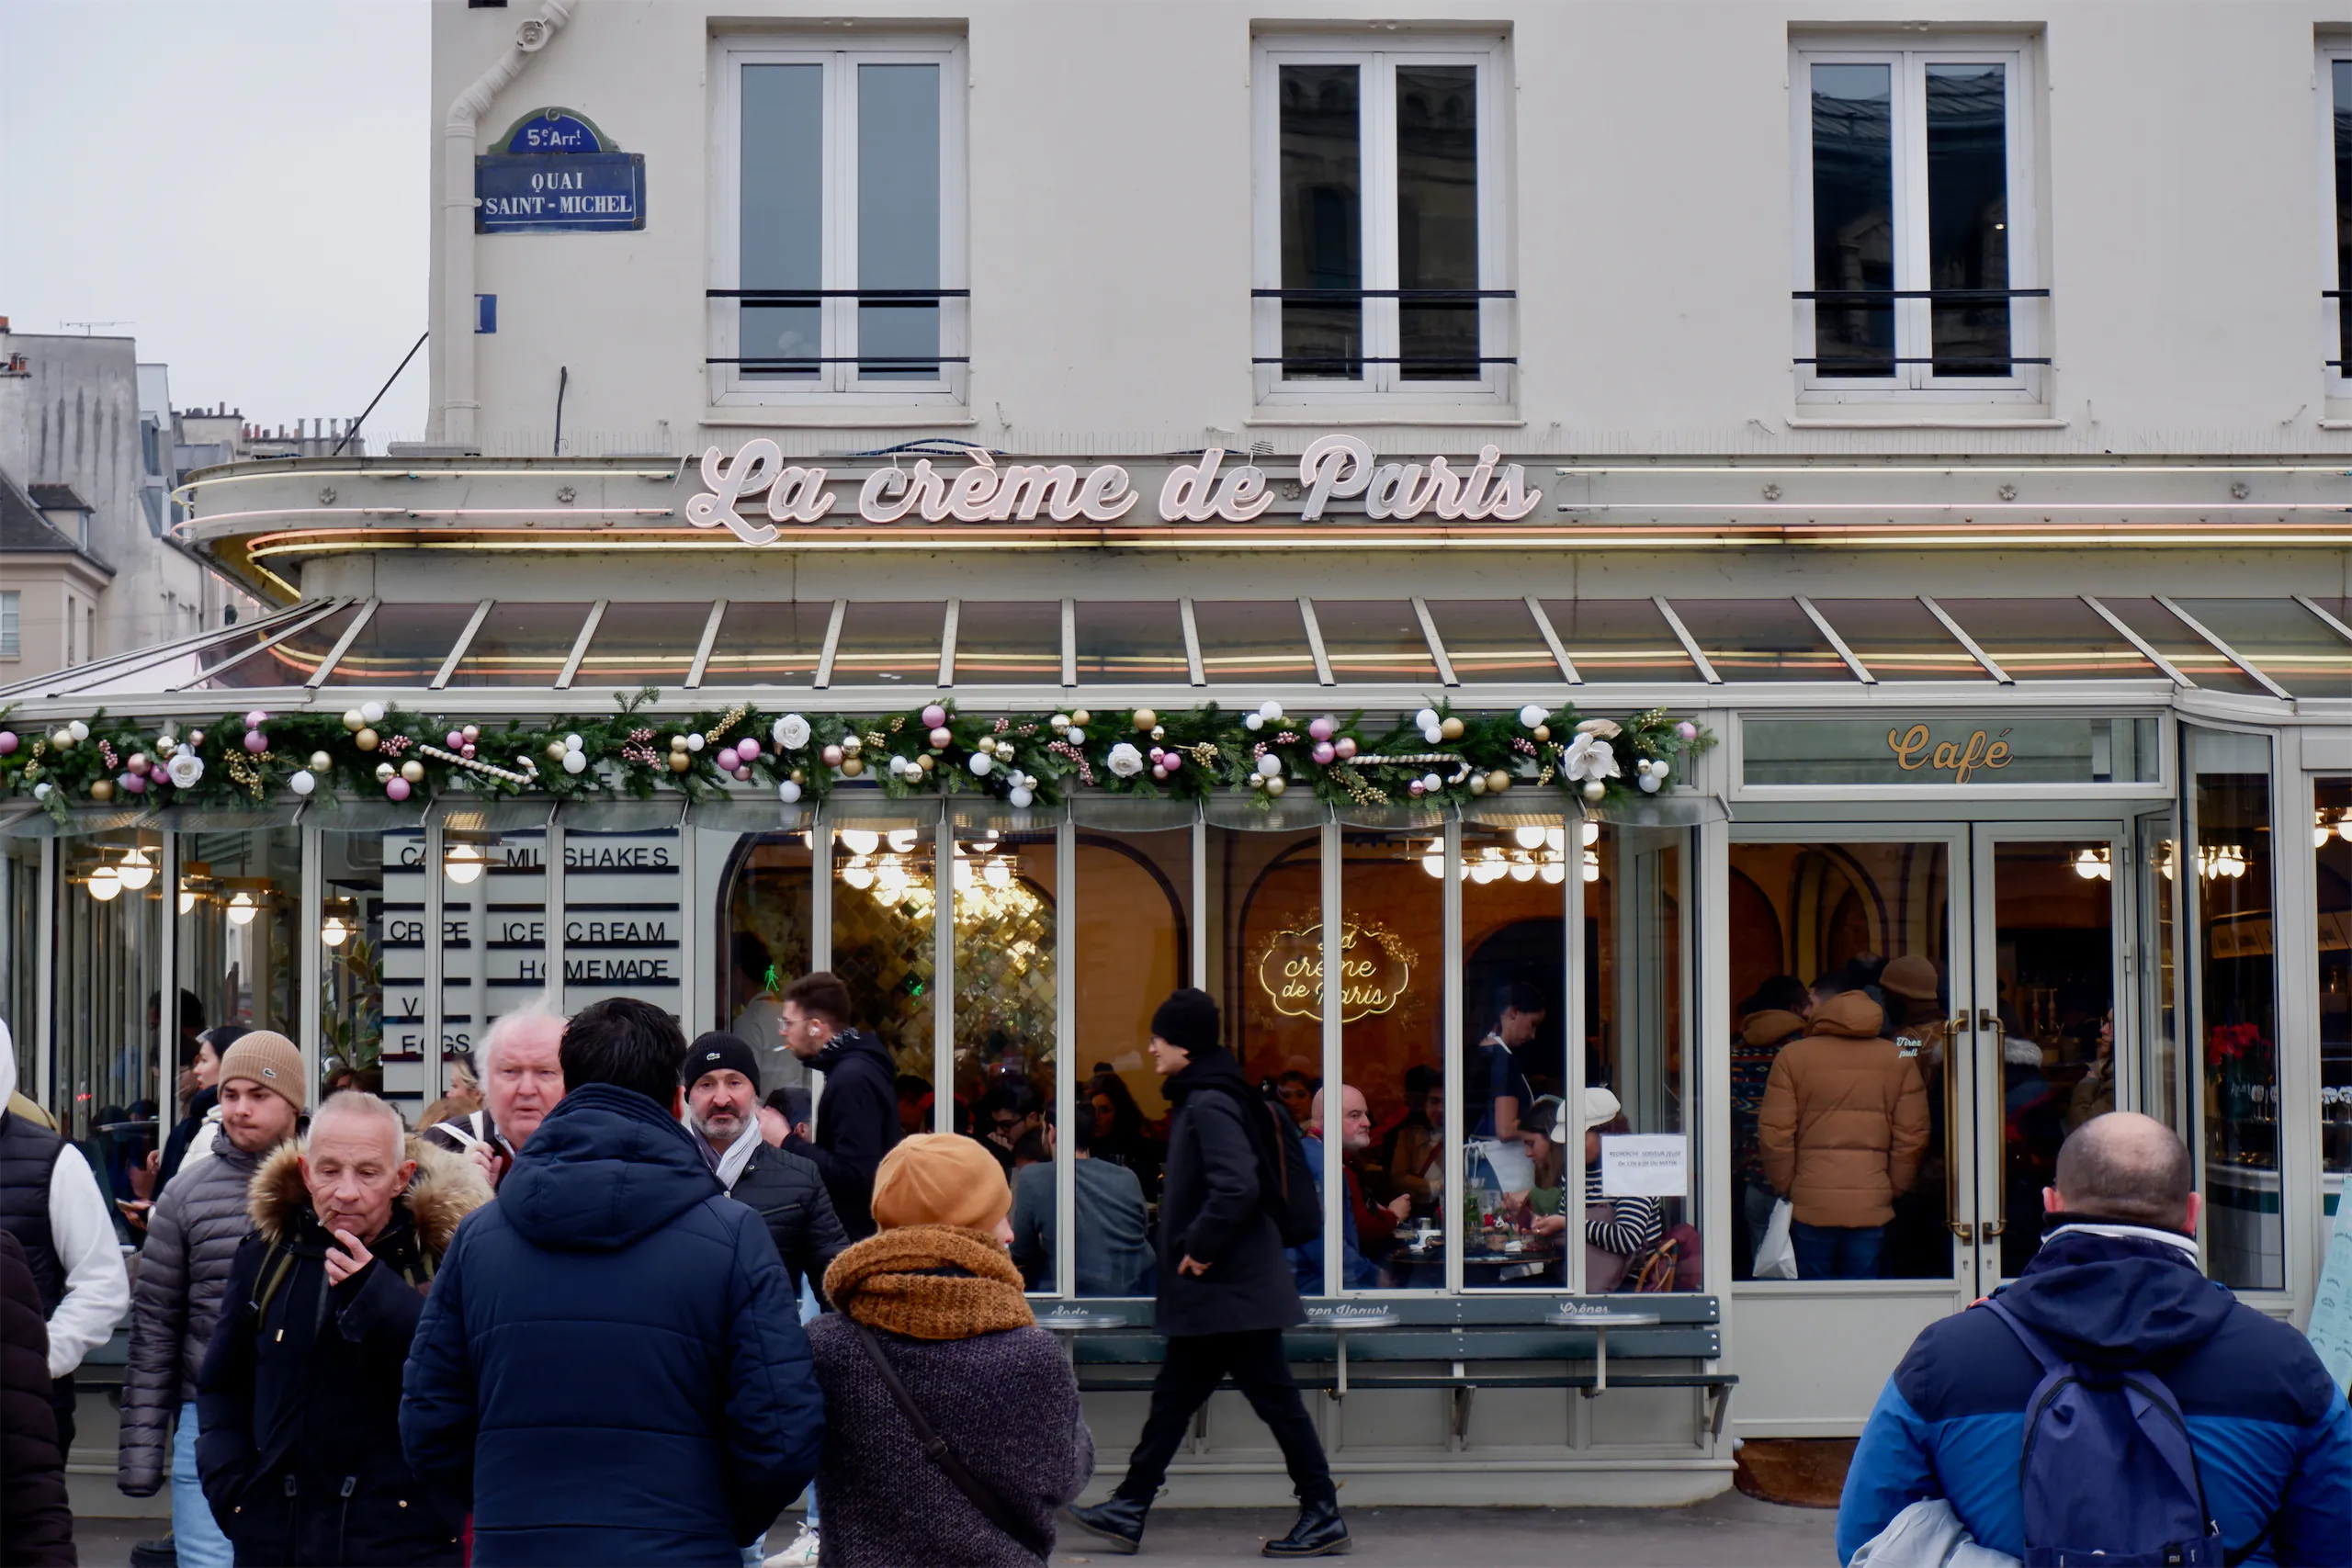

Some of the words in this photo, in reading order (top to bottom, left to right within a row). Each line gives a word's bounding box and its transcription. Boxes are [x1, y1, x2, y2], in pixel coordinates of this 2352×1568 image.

[531, 172, 582, 193] QUAI
[685, 438, 837, 547] La
[859, 446, 1139, 523] crème
[1159, 447, 1276, 523] de
[1299, 434, 1544, 521] Paris
[1887, 723, 2015, 784] Café
[390, 920, 469, 942] CRPE
[503, 922, 545, 942] ICE
[566, 921, 665, 942] CREAM
[520, 960, 669, 980] HMEMADE
[1283, 979, 1310, 998] de
[1896, 1036, 1923, 1046] Tirez
[1898, 1048, 1918, 1059] pull
